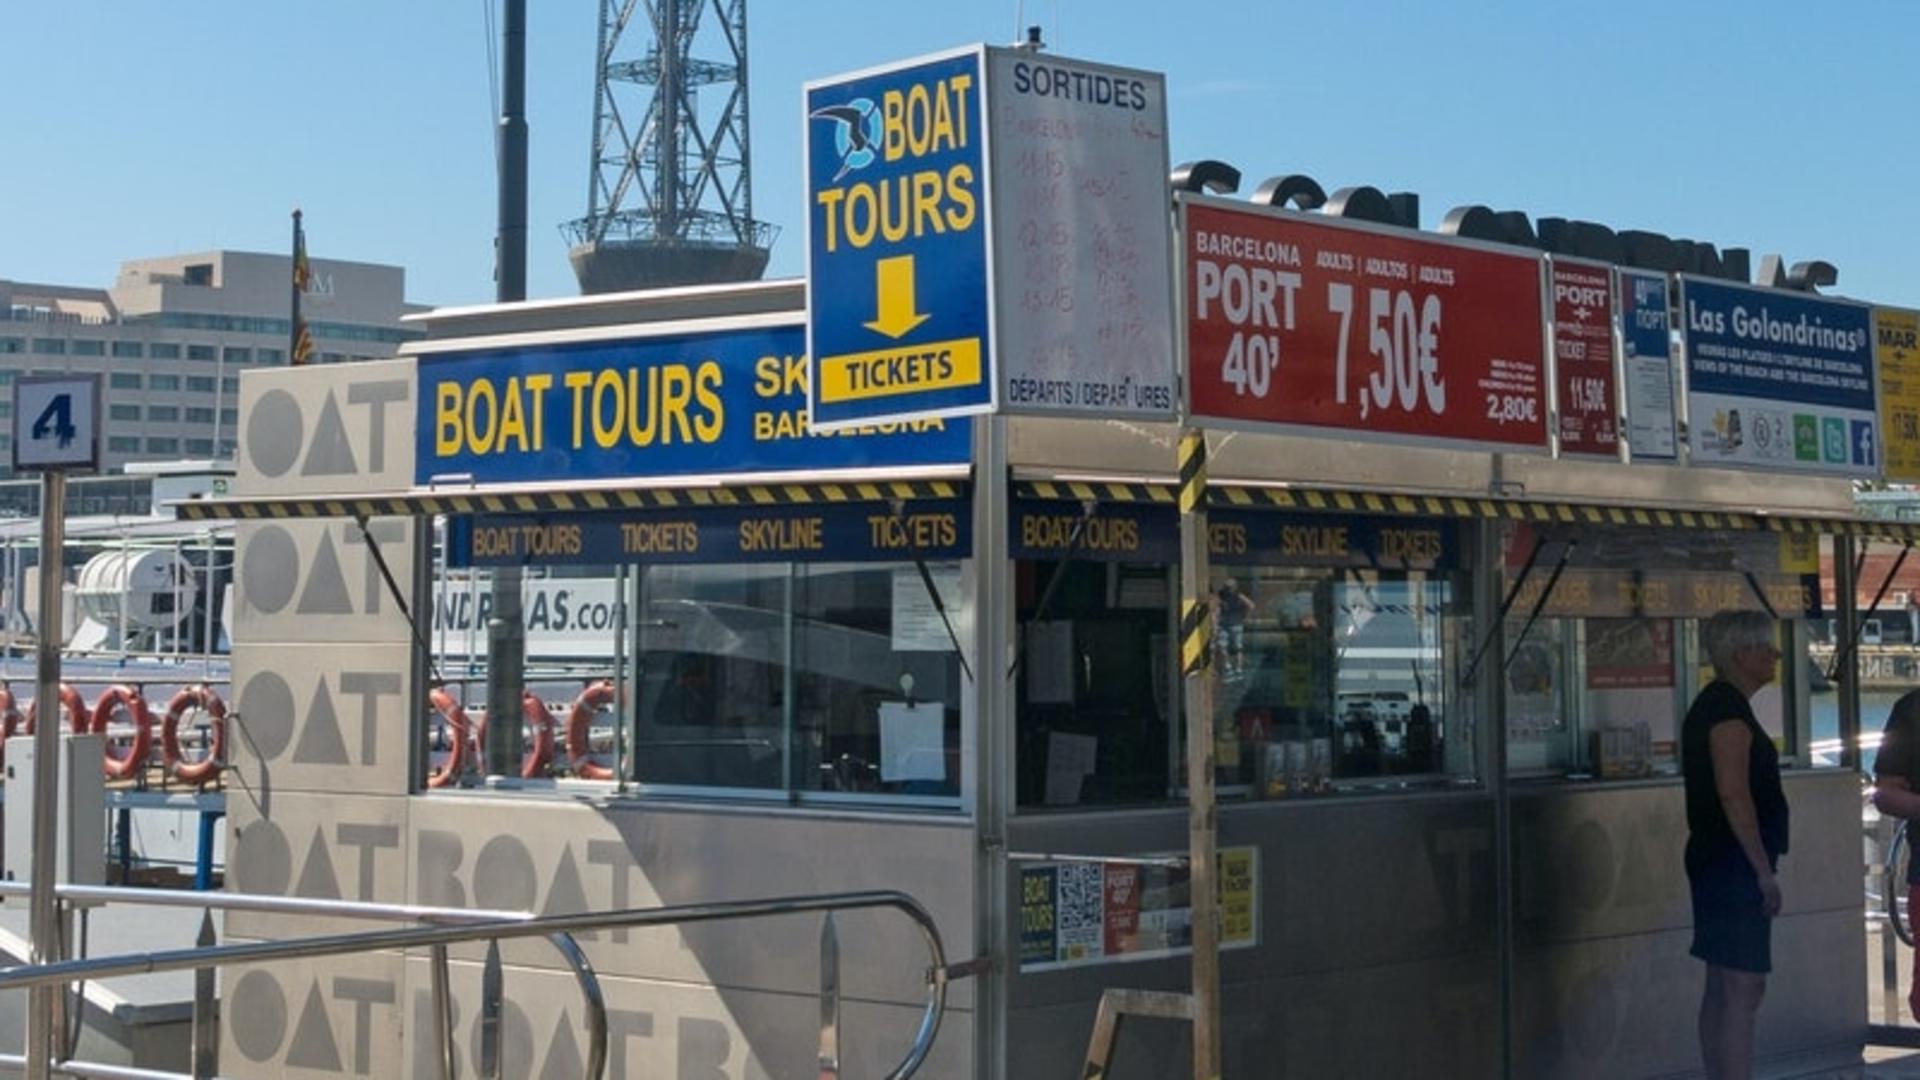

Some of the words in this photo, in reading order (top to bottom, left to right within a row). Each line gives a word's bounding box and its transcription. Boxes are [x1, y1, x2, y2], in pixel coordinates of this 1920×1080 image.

[1014, 62, 1146, 111] SORTIDES
[884, 75, 972, 162] BOAT
[817, 164, 977, 253] TOURS
[1196, 232, 1302, 267] BARCELONA
[1316, 250, 1354, 272] ADULTS
[1366, 257, 1409, 280] ADULTOS
[1419, 265, 1456, 287] ADULTS
[1196, 261, 1302, 331] PORT
[1554, 272, 1607, 287] BARCELONA
[1556, 284, 1608, 308] PORT
[1689, 300, 1726, 336] Las
[846, 351, 953, 391] TICKETS
[1328, 282, 1446, 420] 7,50€
[435, 373, 553, 457] BOAT
[565, 361, 725, 451] TOURS
[1010, 373, 1074, 404] DÉPARTS
[1083, 377, 1170, 409] DEPARURES
[1487, 394, 1539, 425] 2,80€
[32, 393, 76, 450] 4
[472, 525, 521, 557] BOAT
[523, 523, 581, 556] TOURS
[622, 521, 698, 554] TICKETS
[740, 517, 823, 551] SKYLINE
[1022, 514, 1071, 549] BOAT
[1281, 525, 1348, 557] SKYLINE
[1381, 529, 1441, 560] TICKETS
